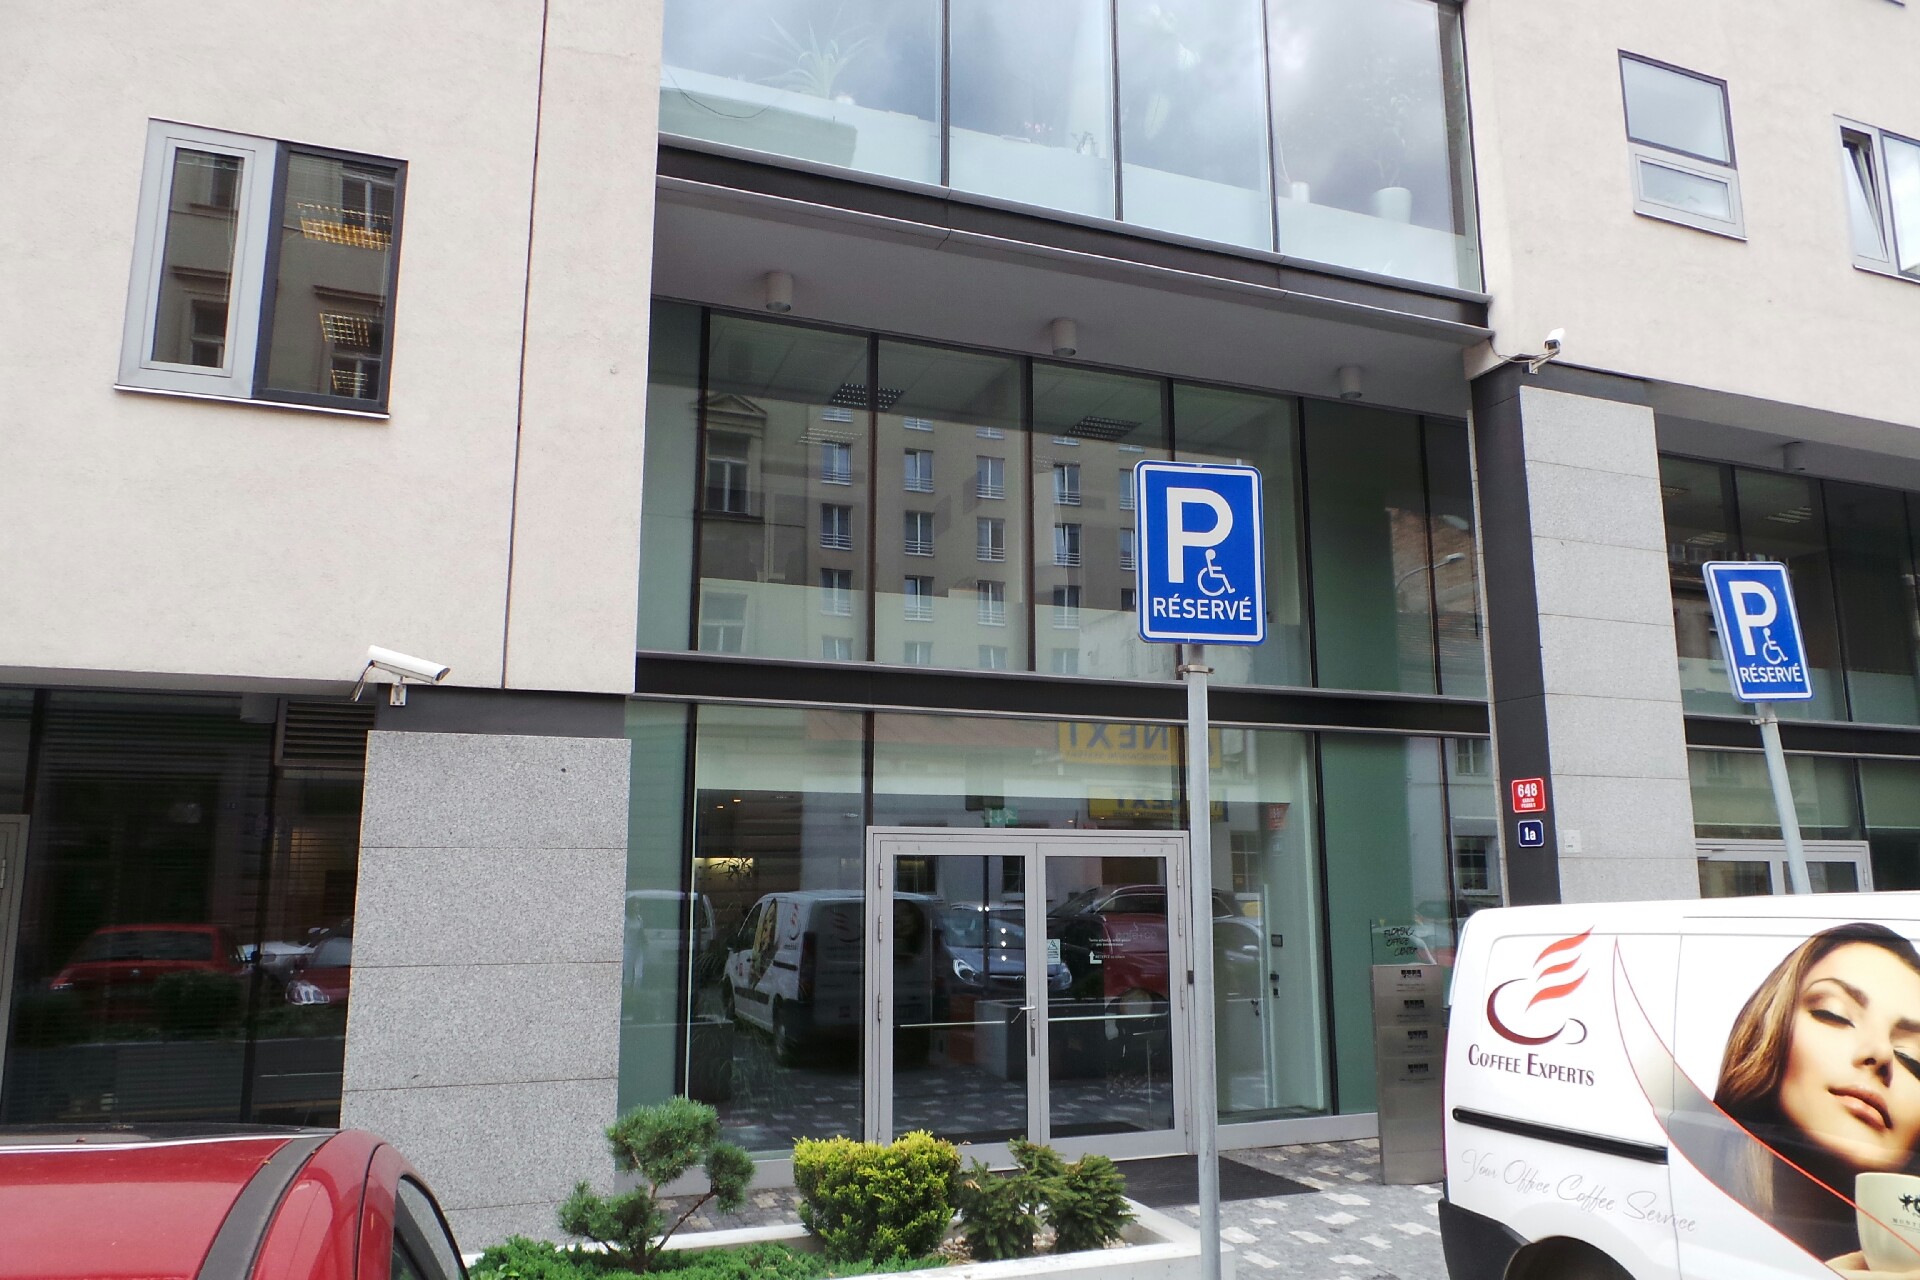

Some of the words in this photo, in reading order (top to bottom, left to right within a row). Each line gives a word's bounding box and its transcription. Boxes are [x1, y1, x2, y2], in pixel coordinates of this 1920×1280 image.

[1167, 487, 1233, 583] P
[1153, 593, 1252, 621] RÉSERVÉ
[1728, 581, 1777, 656] P
[1740, 663, 1803, 682] RÉSERVÉ
[1517, 782, 1538, 798] 648
[1524, 827, 1537, 841] 1a
[1468, 1043, 1521, 1074] COFFEE
[1527, 1053, 1595, 1086] EXPERTS
[1462, 1149, 1498, 1182] Your
[1503, 1160, 1550, 1194] Office
[1556, 1175, 1616, 1212] Coffee
[1623, 1191, 1696, 1232] Service
